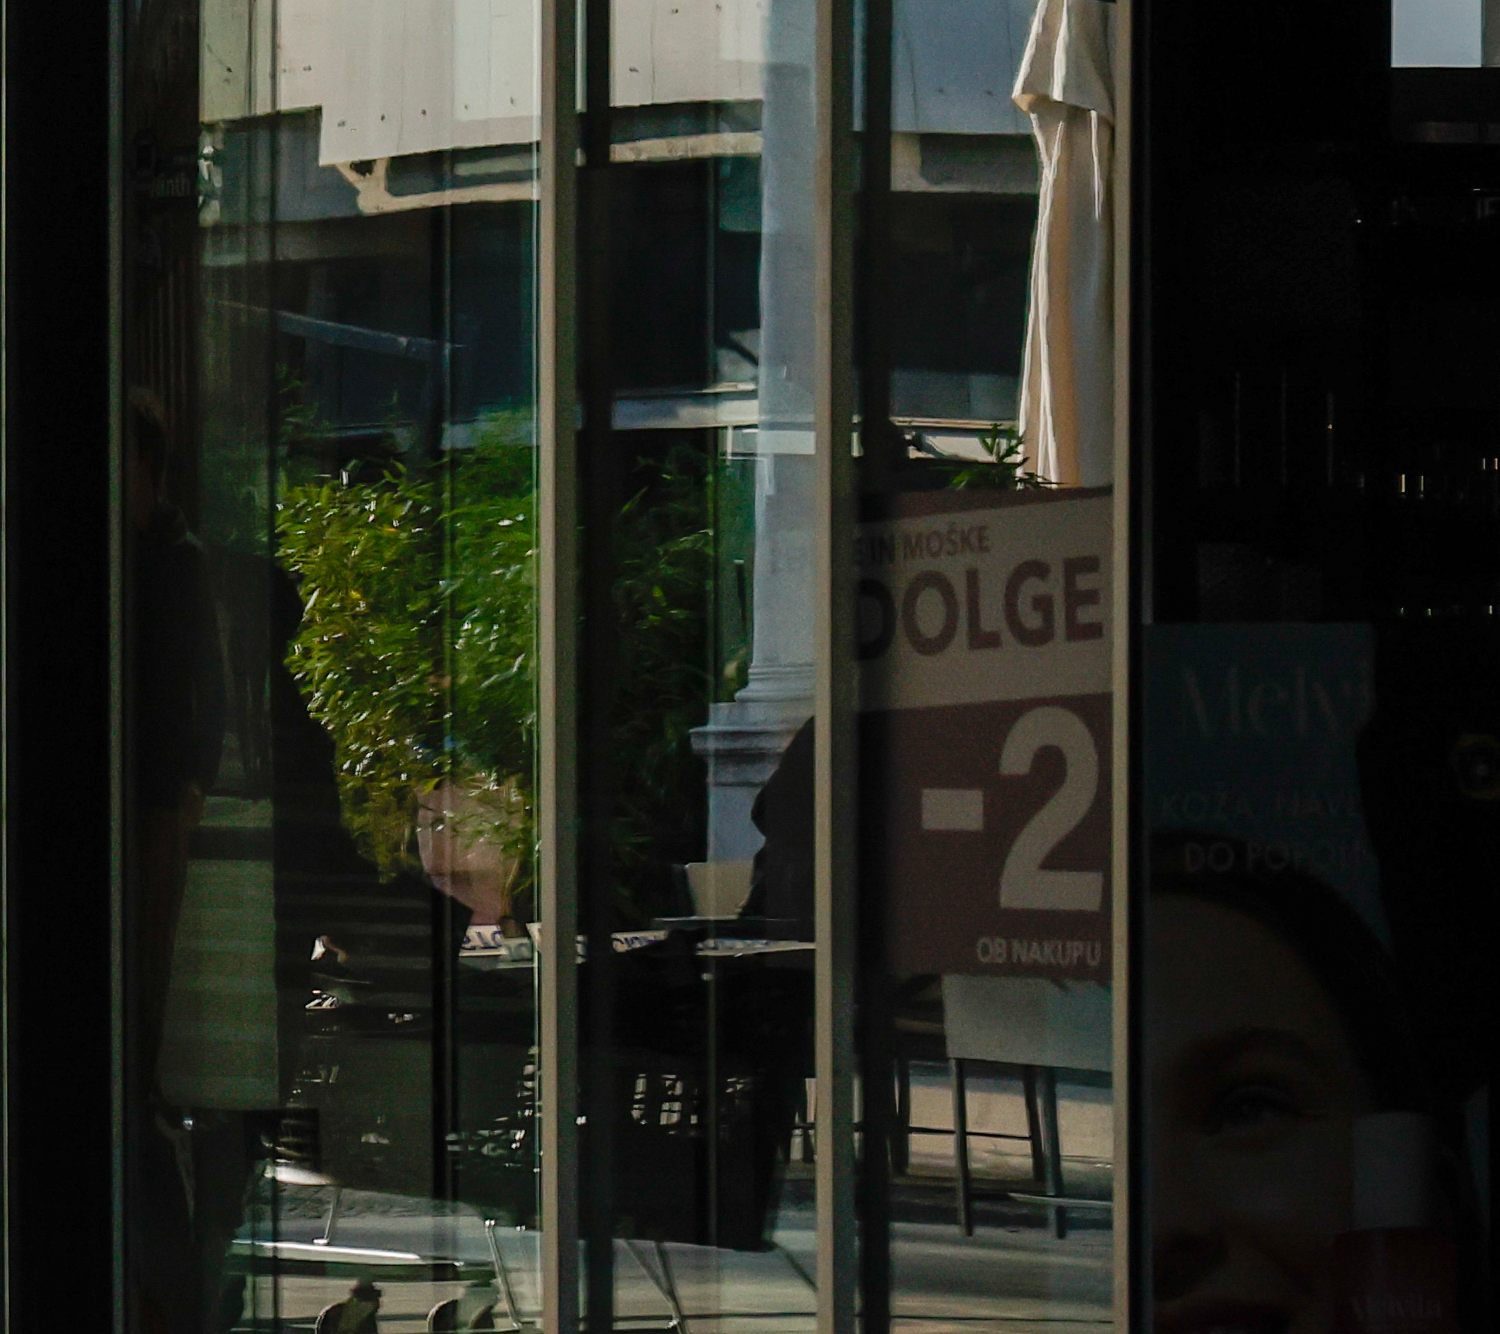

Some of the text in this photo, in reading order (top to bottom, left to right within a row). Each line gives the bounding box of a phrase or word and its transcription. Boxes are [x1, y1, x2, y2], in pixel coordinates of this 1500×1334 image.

[903, 522, 992, 561] MOŠKE
[1184, 842, 1236, 873] DO
[976, 936, 1101, 967] OB NAKUPU
